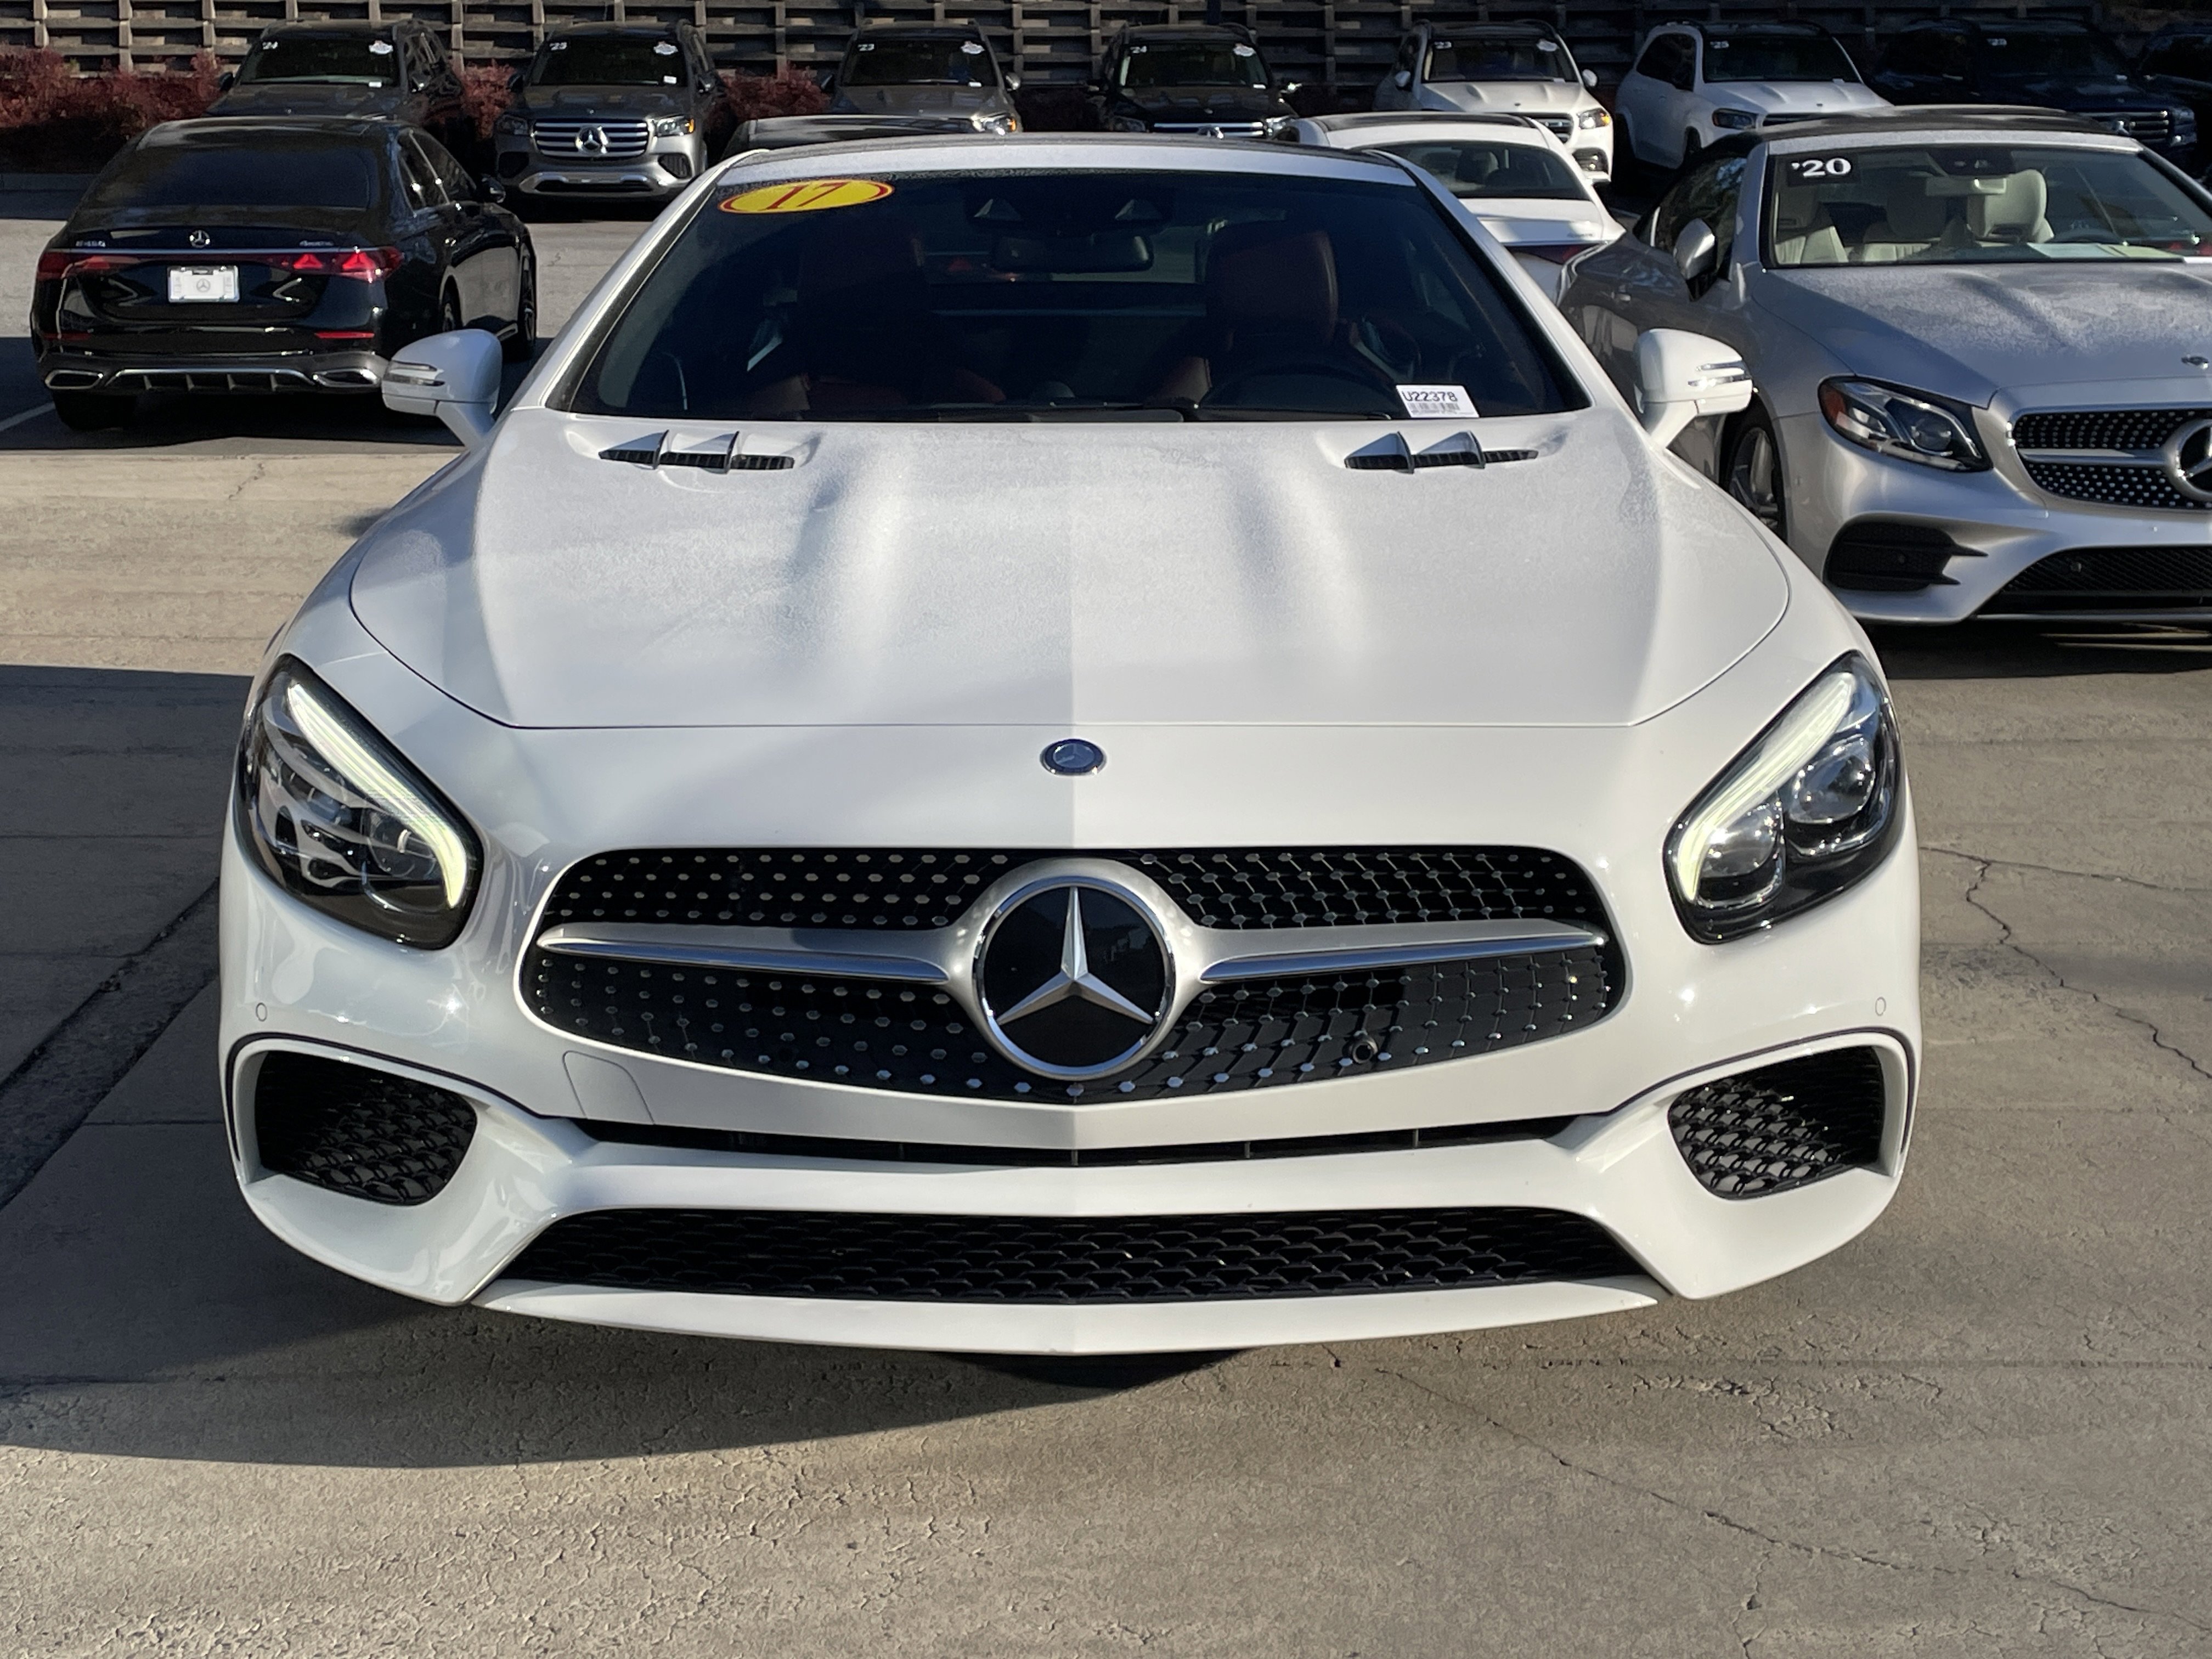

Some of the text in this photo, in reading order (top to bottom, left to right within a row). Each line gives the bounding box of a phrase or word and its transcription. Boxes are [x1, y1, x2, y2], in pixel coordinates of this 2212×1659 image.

[1791, 157, 1852, 176] '20
[760, 182, 850, 210] 17
[1402, 391, 1458, 402] U22378
